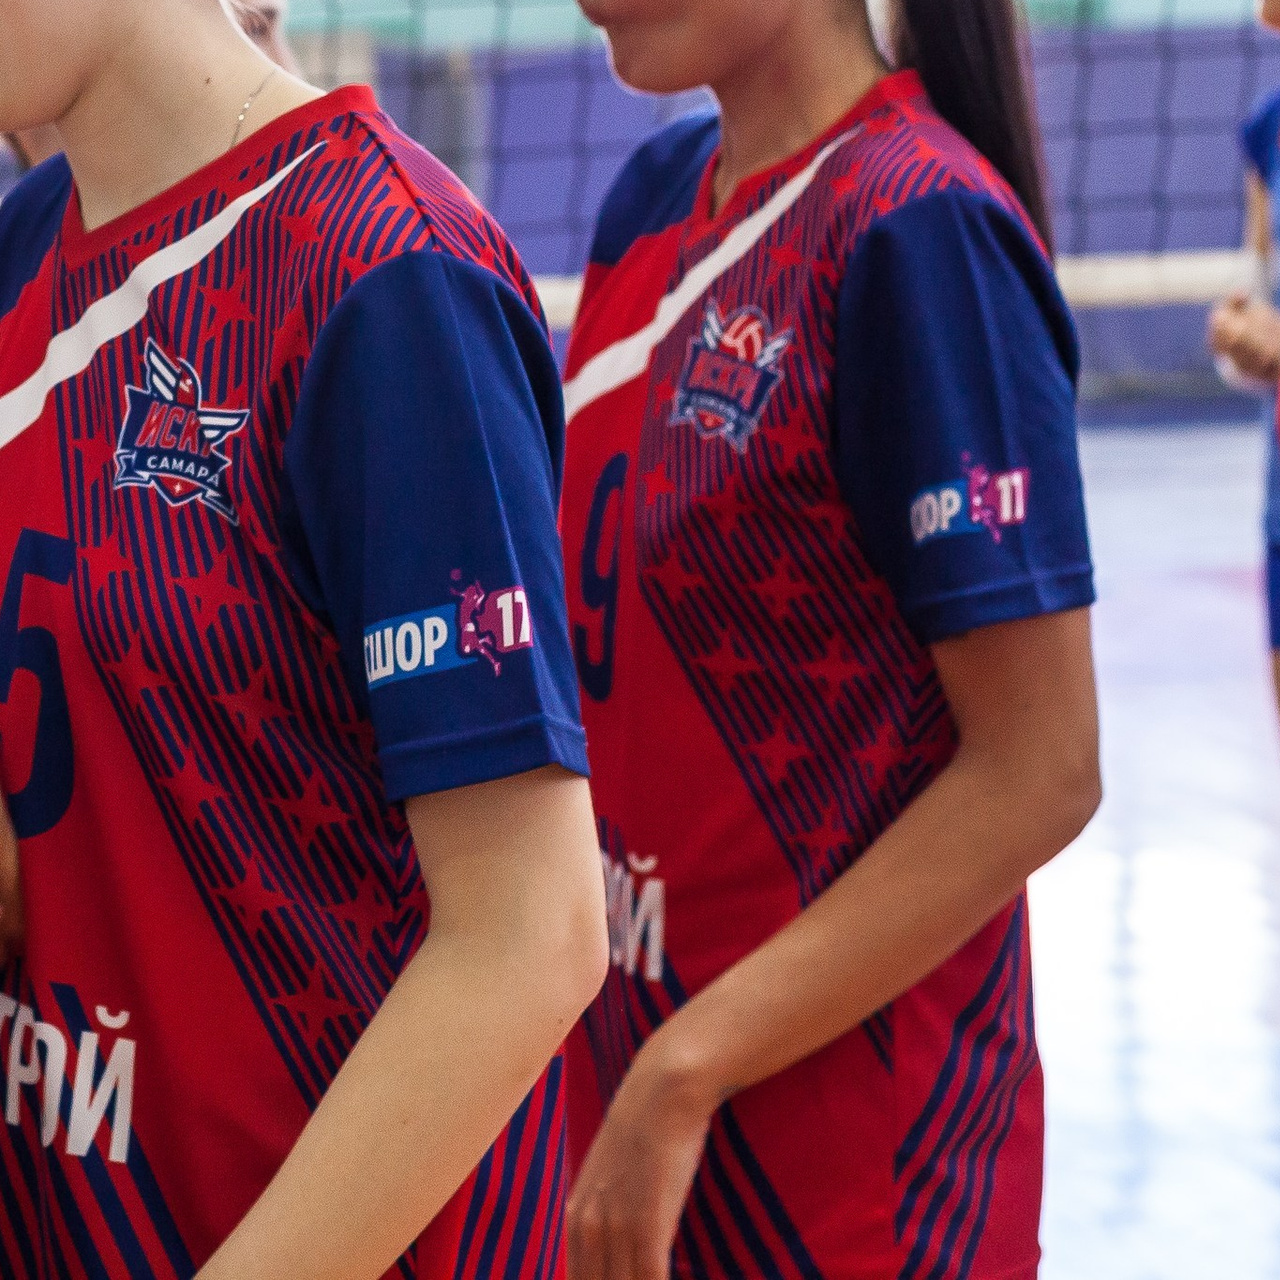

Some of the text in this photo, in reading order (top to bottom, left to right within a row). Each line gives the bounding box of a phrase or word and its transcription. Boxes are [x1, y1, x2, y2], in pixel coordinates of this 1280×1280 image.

[146, 455, 220, 488] САМАРА
[995, 471, 1025, 522] 11
[574, 452, 629, 702] 9
[364, 616, 449, 684] ШОР
